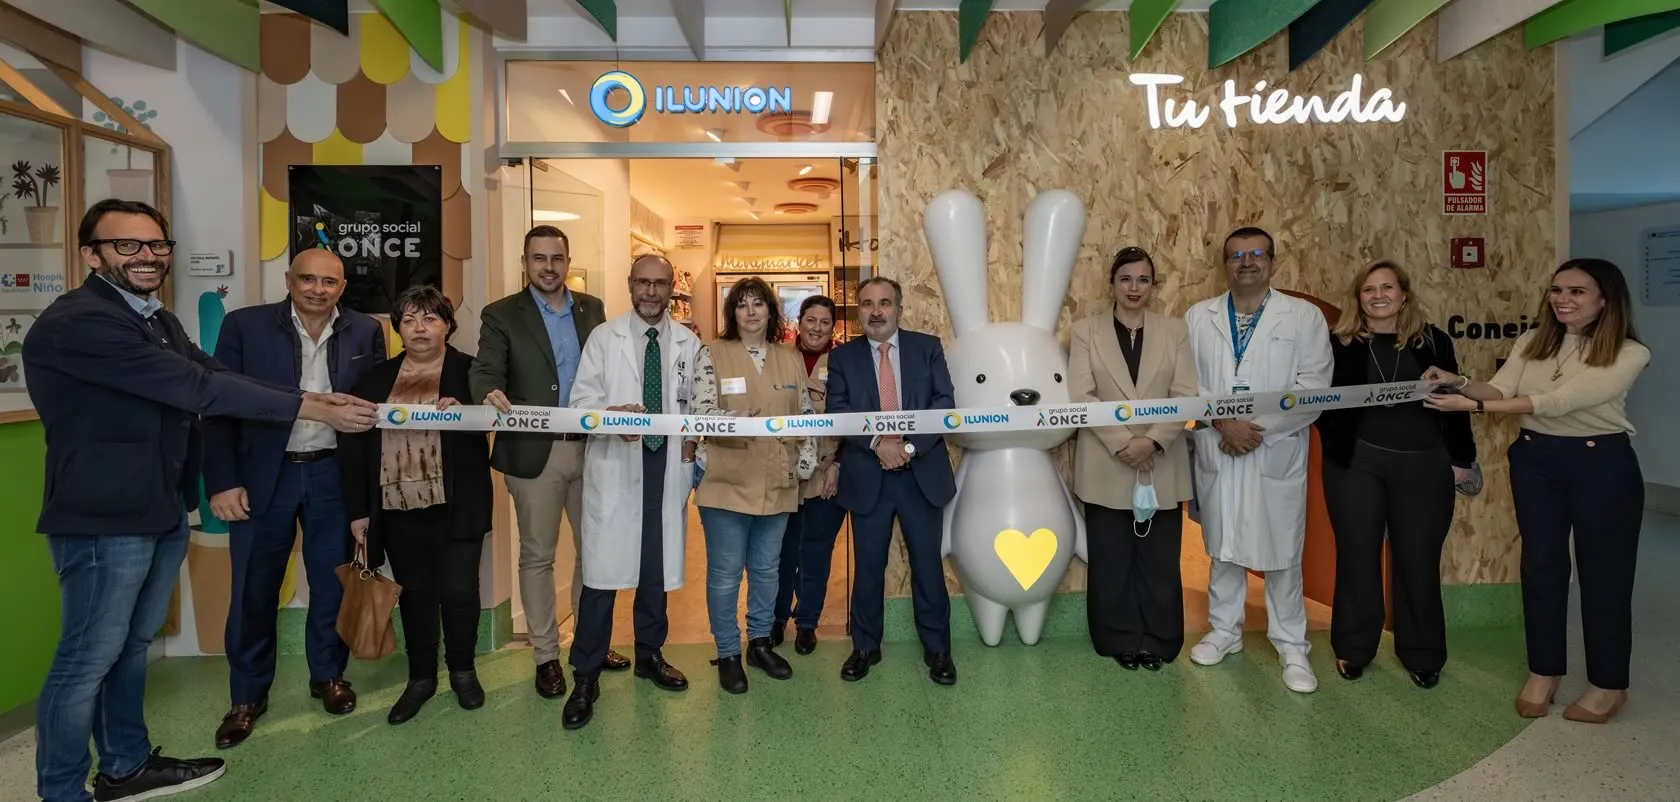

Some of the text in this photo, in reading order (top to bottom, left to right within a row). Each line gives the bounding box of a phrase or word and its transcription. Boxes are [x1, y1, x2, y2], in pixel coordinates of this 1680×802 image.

[655, 85, 792, 114] ILUNION
[1129, 73, 1406, 129] Tu tienda
[1447, 196, 1483, 204] PULSADOR
[338, 221, 421, 236] grupo social
[338, 237, 421, 258] ONCE
[713, 254, 823, 269] Minimarket
[1447, 314, 1541, 339] Cone
[1379, 385, 1398, 393] grupo
[1298, 394, 1341, 405] ILUNION
[1375, 391, 1414, 402] ONCE
[507, 409, 551, 417] grupo social
[1048, 407, 1068, 415] grupo
[1134, 405, 1178, 416] ILUNION
[1216, 404, 1254, 416] ONCE
[411, 411, 462, 422] ILUNION
[602, 416, 651, 427] ILUNION
[964, 414, 1009, 424] ILUNION
[1050, 414, 1088, 425] ONCE
[506, 417, 550, 429] ONCE
[694, 422, 736, 433] ONCE
[787, 418, 834, 428] ILUNION
[875, 421, 916, 432] ONCE
